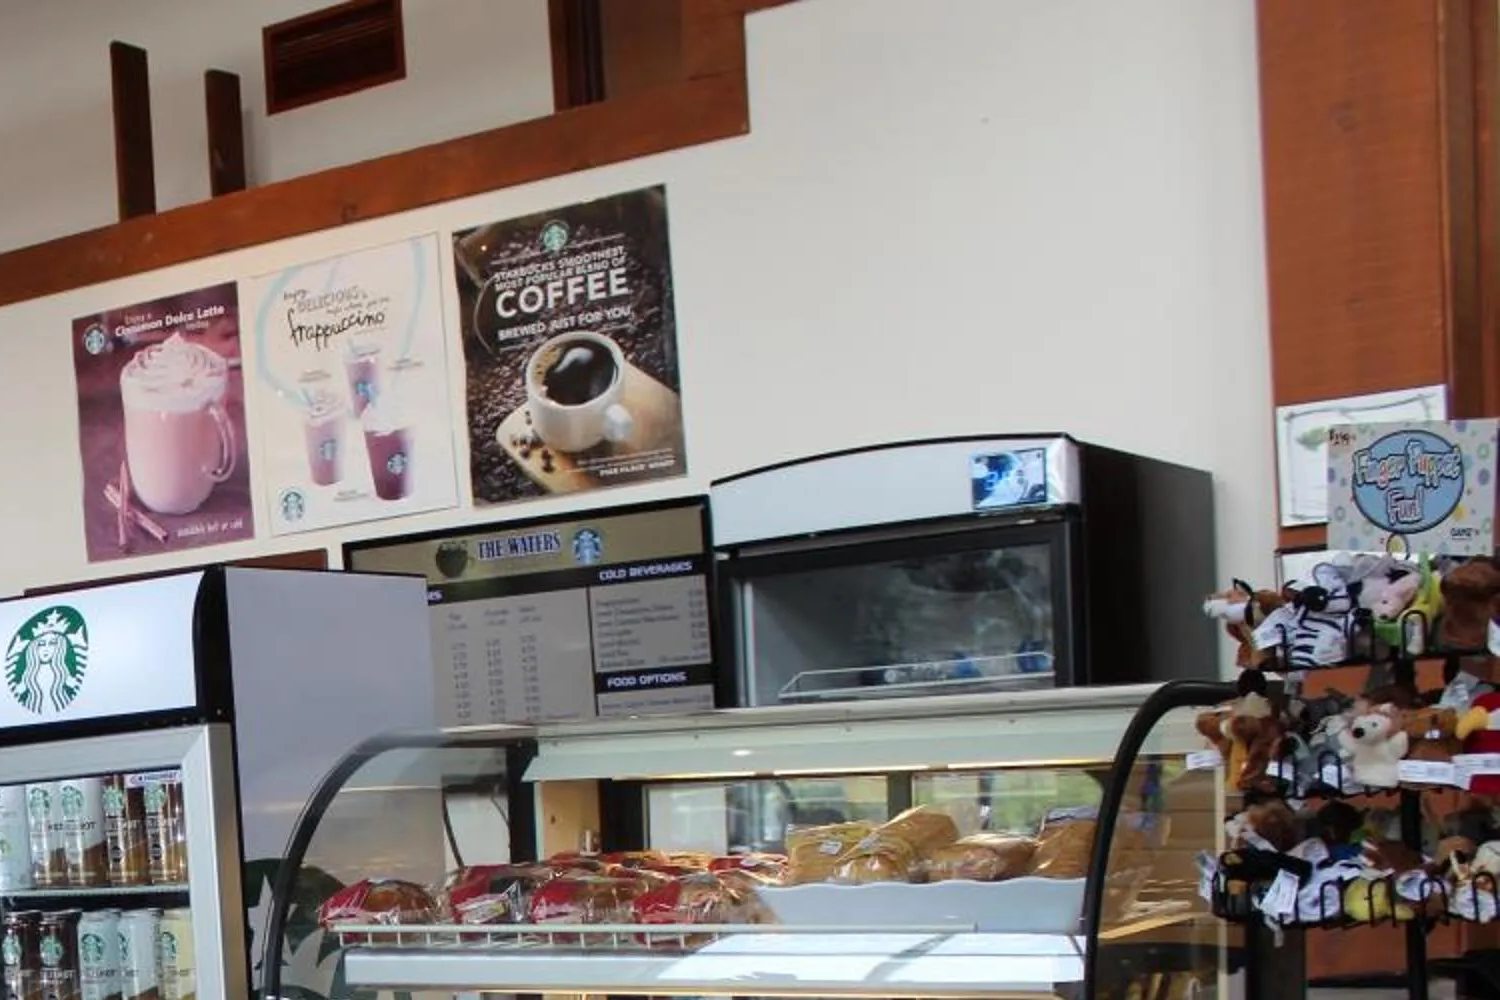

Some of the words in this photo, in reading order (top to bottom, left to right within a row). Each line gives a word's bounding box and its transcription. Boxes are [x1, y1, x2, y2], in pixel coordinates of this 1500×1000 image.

[494, 261, 556, 282] STARBUCKS
[495, 278, 523, 292] MOST
[525, 267, 574, 286] POPULAR
[575, 260, 609, 275] BLEND
[612, 255, 627, 267] OF
[495, 267, 630, 319] COFFEE
[196, 304, 226, 320] Latte
[497, 321, 548, 342] BREWED
[549, 315, 577, 333] JUST
[578, 311, 604, 326] FOR
[478, 541, 503, 561] THE
[506, 532, 563, 559] WATERS
[599, 568, 627, 582] COLD
[629, 561, 694, 578] BEVERAGES
[607, 676, 637, 688] FOOD
[639, 671, 688, 686] OPTIONS
